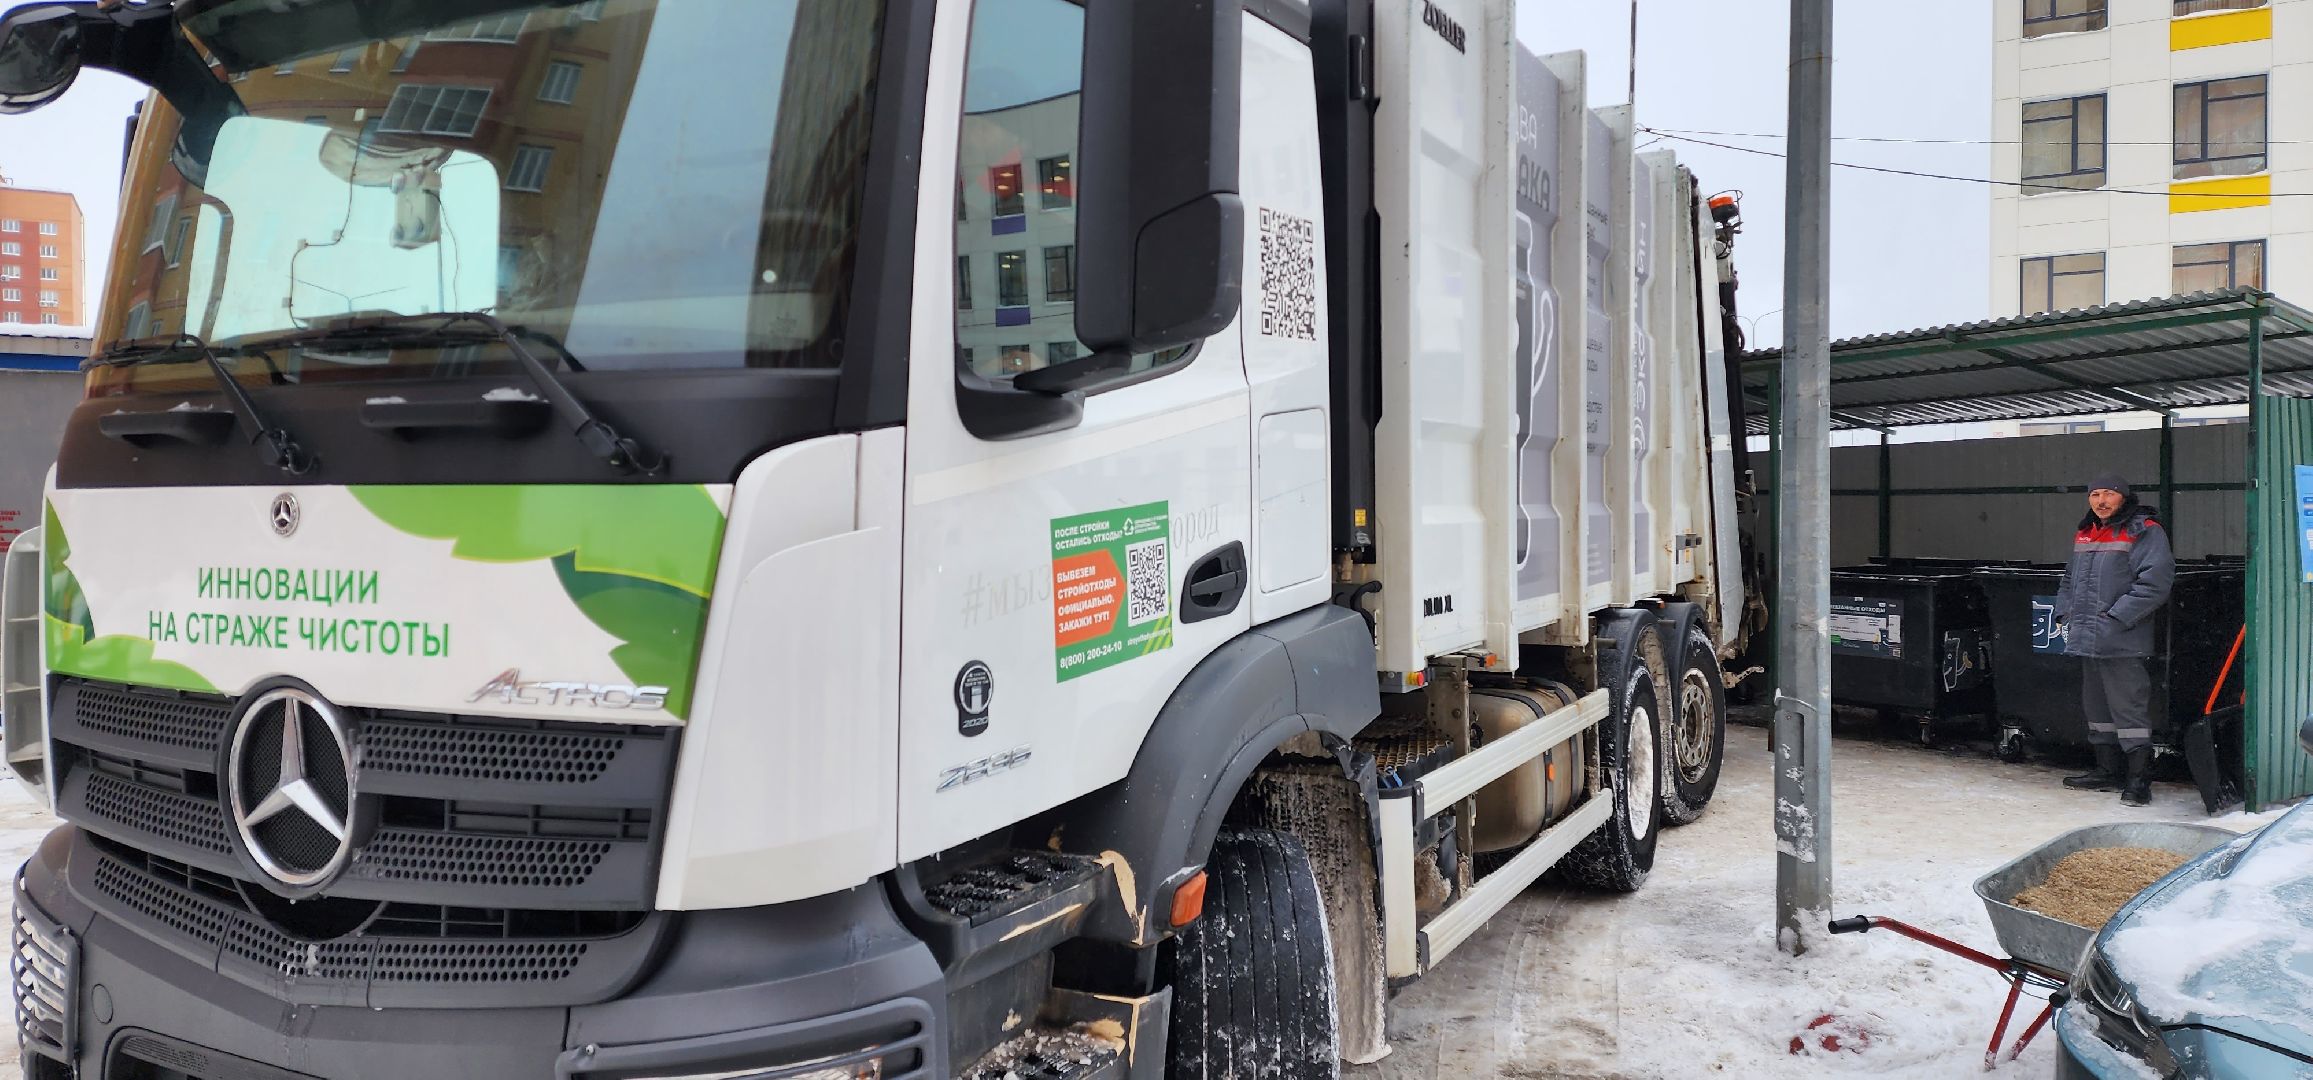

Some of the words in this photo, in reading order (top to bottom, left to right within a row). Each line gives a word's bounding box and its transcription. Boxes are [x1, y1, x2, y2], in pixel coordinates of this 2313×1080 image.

[1516, 104, 1537, 149] ВА
[1516, 153, 1550, 212] АКА
[1054, 525, 1080, 538] ПОСЛЕ
[1079, 520, 1110, 534] СТРОЙКИ
[1055, 534, 1092, 550] ОСТАЛИСЬ
[962, 566, 1051, 630] #мыз
[1169, 503, 1220, 558] ород
[1056, 566, 1096, 583] ВЫВЕЗЕМ
[198, 567, 378, 607] ИННОВАЦИИ
[1057, 577, 1117, 600] СТРОЙОТХОДЫ
[149, 610, 178, 642] НА
[185, 612, 288, 649] СТРАЖЕ
[299, 617, 449, 657] ЧИСТОТЫ
[1058, 616, 1092, 633] ЗАКАЖИ
[1094, 611, 1110, 623] ТУТ!
[1060, 652, 1085, 669] 8(800)
[1087, 640, 1122, 660] 200-24-10
[465, 668, 669, 710] ACTROS
[963, 716, 988, 728] 2020
